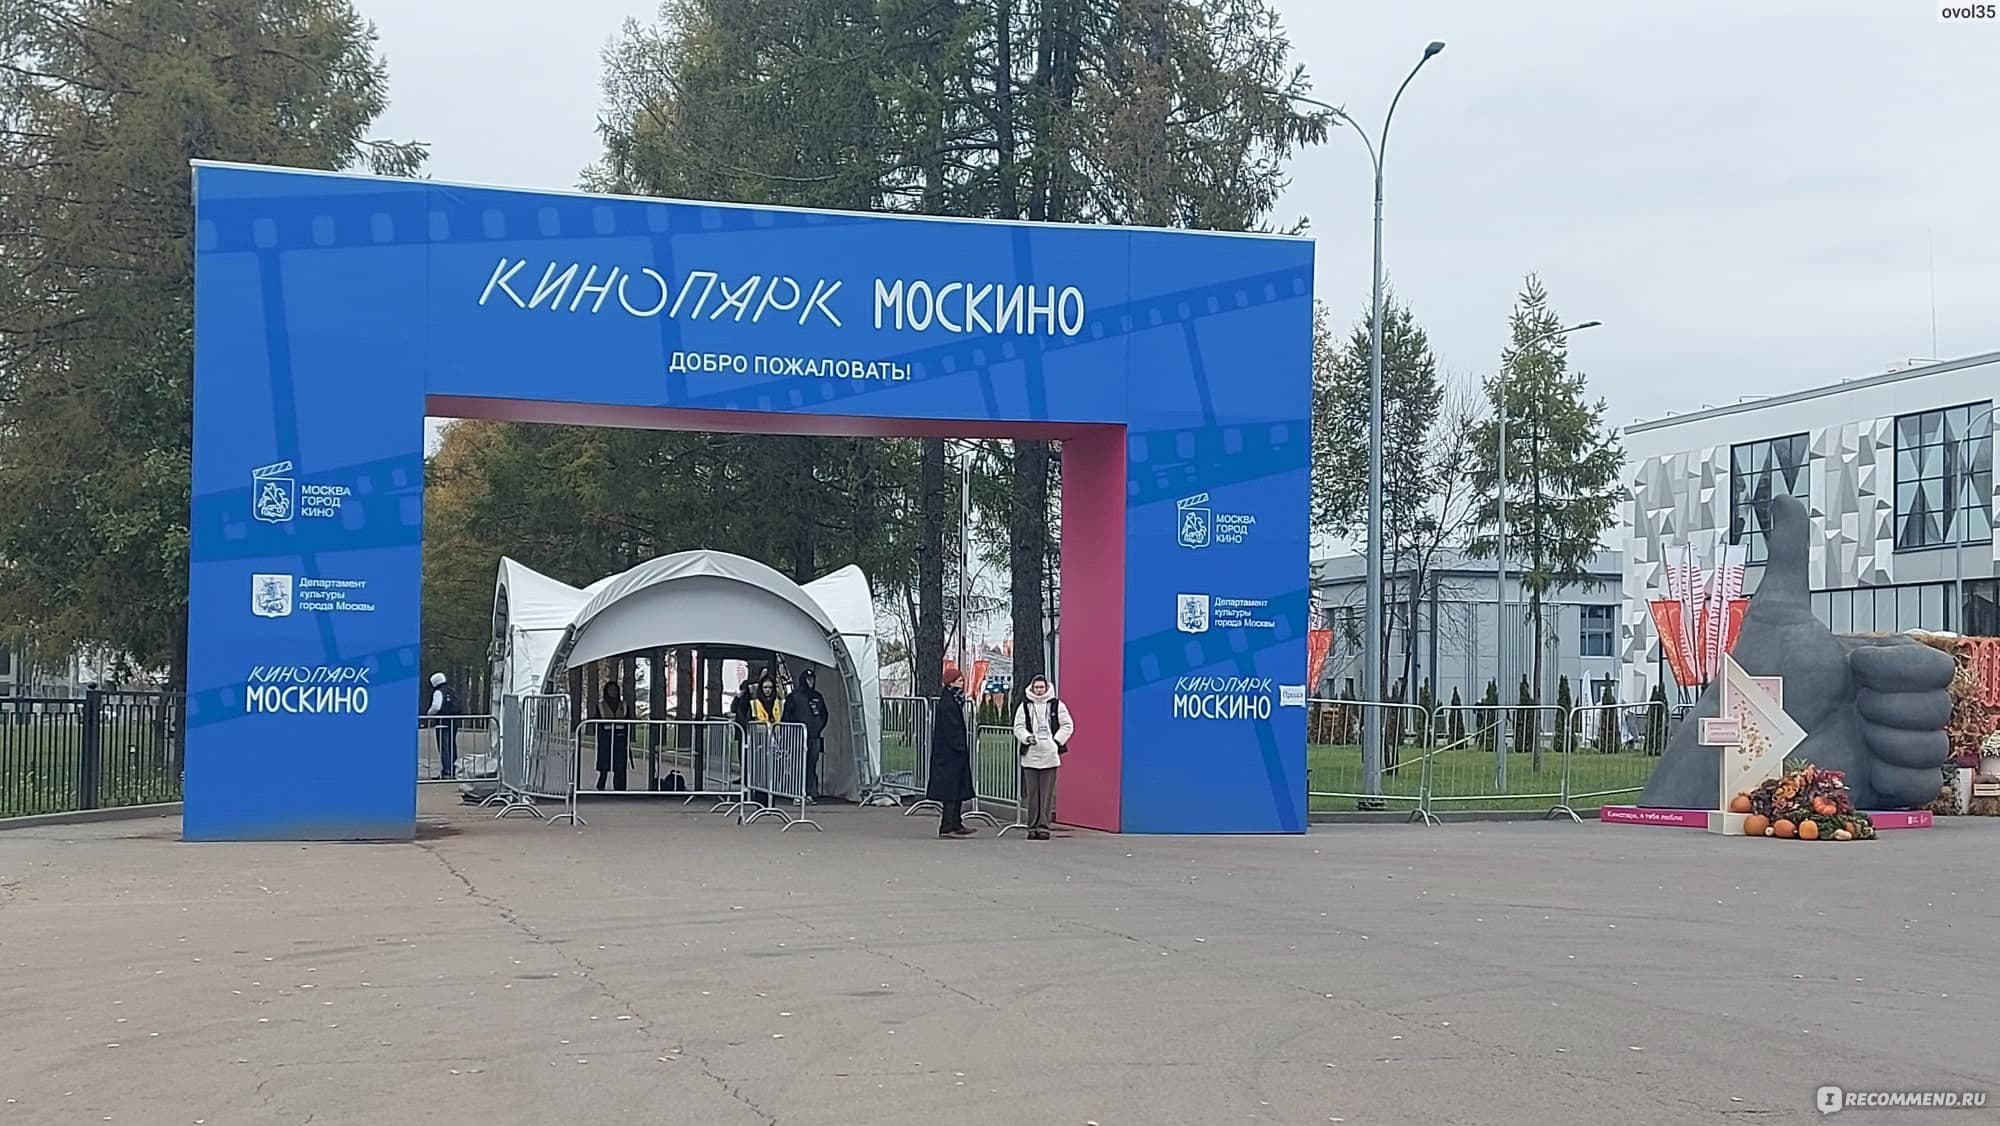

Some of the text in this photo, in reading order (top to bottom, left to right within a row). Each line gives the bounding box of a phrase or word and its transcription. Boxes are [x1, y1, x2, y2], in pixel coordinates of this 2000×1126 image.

[478, 257, 1085, 336] КИНОПАРК МОСКИНО
[668, 351, 912, 381] ДОБРО ПОЖАЛОВАТЬ!
[301, 484, 351, 496] МОСКВА
[301, 496, 341, 508] ГОРОД
[301, 507, 334, 517] КИНО
[1216, 514, 1256, 524] МОСКВА
[1216, 524, 1248, 535] ГОРОД
[1216, 534, 1242, 543] КИНО
[299, 577, 366, 588] Департамент
[300, 591, 345, 600] культуры
[300, 601, 375, 611] города Москвы
[1214, 597, 1268, 607] Департамент
[1215, 609, 1251, 618] культуры
[1215, 618, 1275, 628] города Москвы
[247, 666, 370, 683] КИНОПАРК
[1175, 676, 1272, 693] КИНОПАРК
[246, 685, 369, 713] МОСКИНО
[1173, 693, 1272, 720] МОСКИНО
